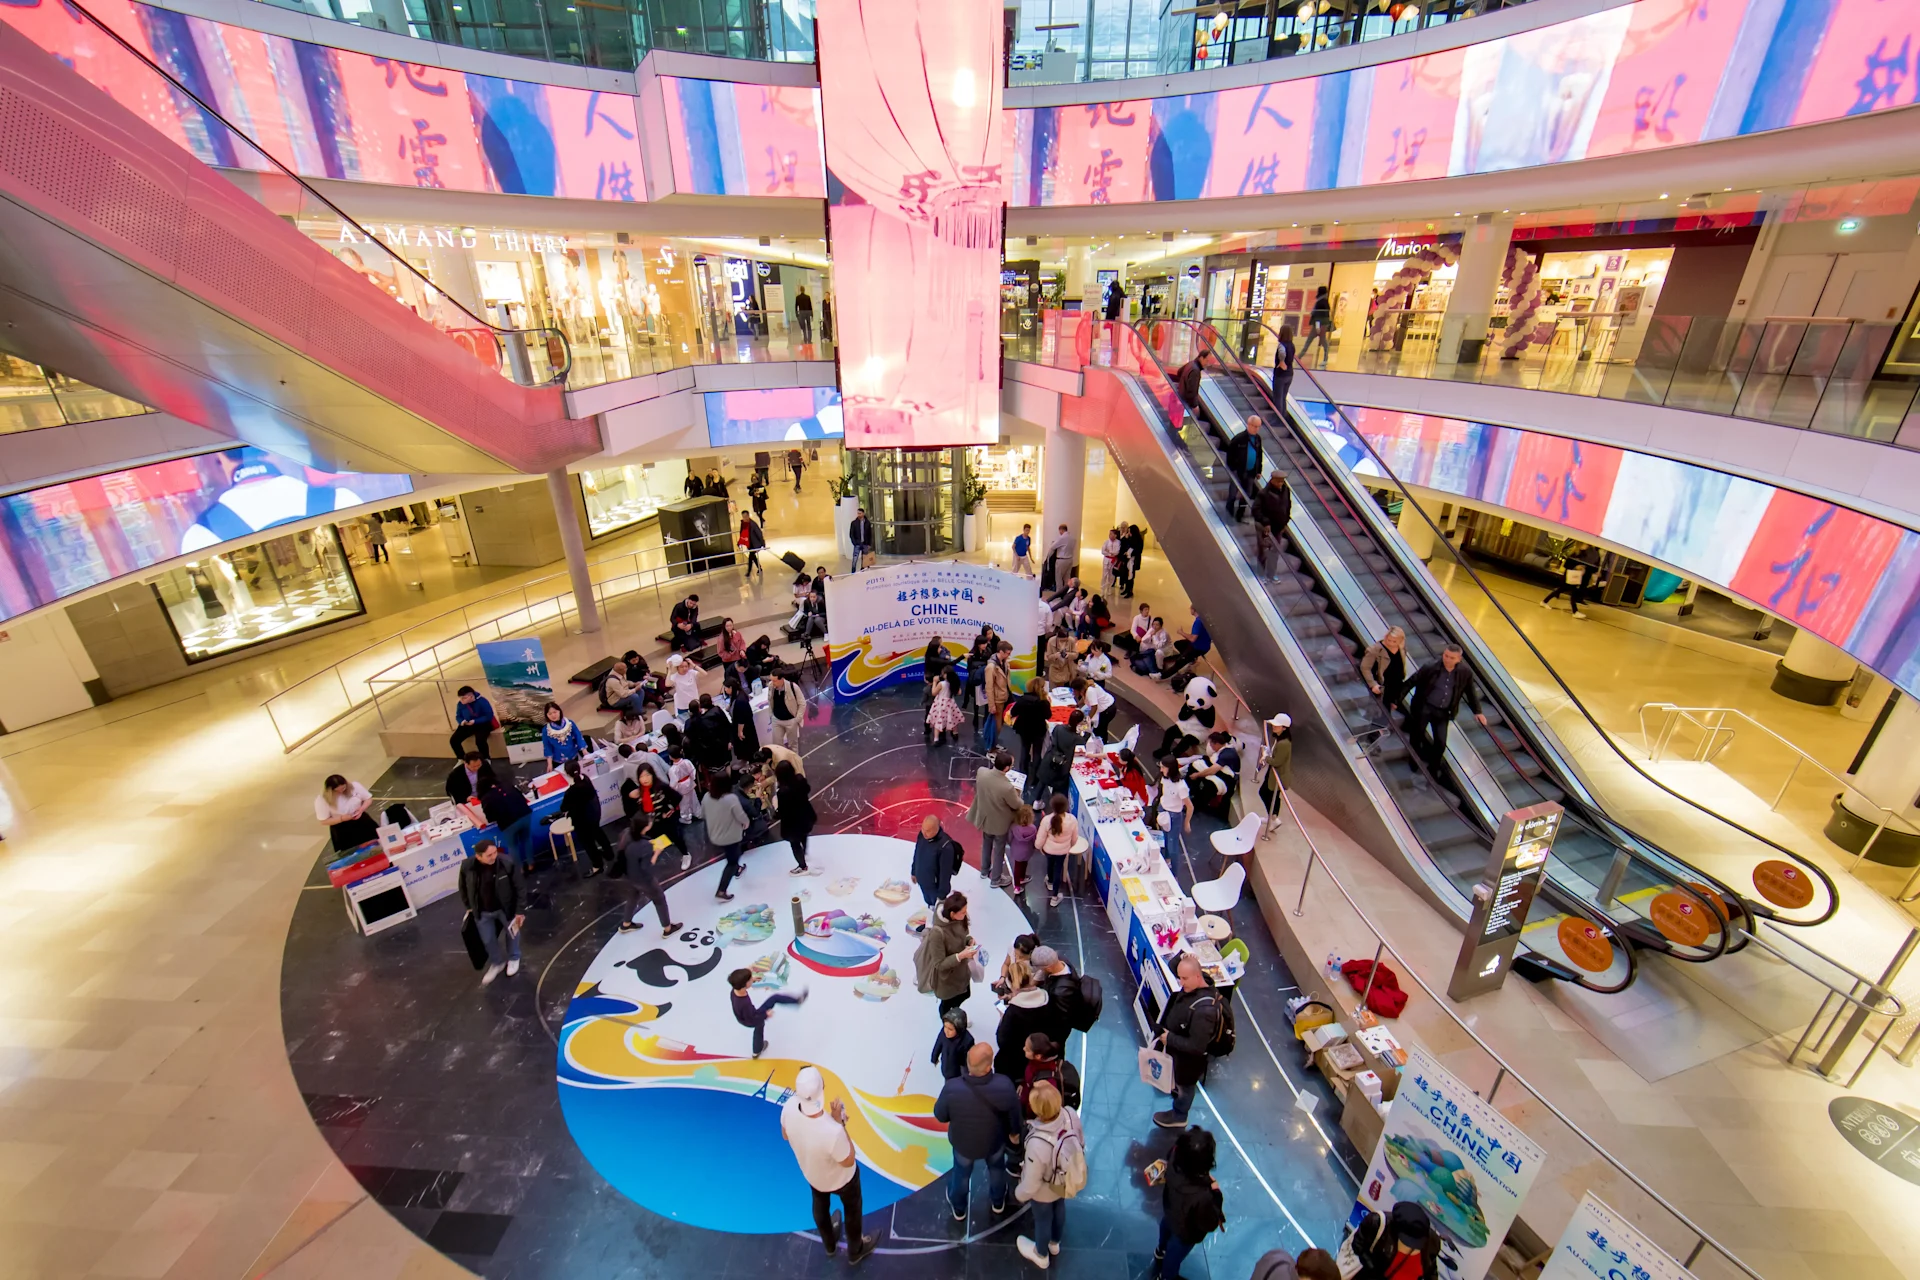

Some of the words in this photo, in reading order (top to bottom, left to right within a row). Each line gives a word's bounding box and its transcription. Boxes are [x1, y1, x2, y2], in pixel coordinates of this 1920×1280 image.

[339, 223, 477, 249] ARMAND
[489, 232, 570, 254] THIERY
[1375, 237, 1444, 261] Marion
[865, 577, 885, 585] 2019
[911, 604, 959, 616] CHINE
[863, 619, 901, 635] AU-DELÀ
[903, 618, 915, 627] DE
[917, 617, 948, 626] VOTRE
[1400, 1091, 1430, 1120] AU-DELÀ
[1431, 1117, 1442, 1130] DE
[1442, 1129, 1467, 1153] VOTRE
[1467, 1150, 1518, 1199] IMAGINATION
[1429, 1105, 1492, 1165] CHINE
